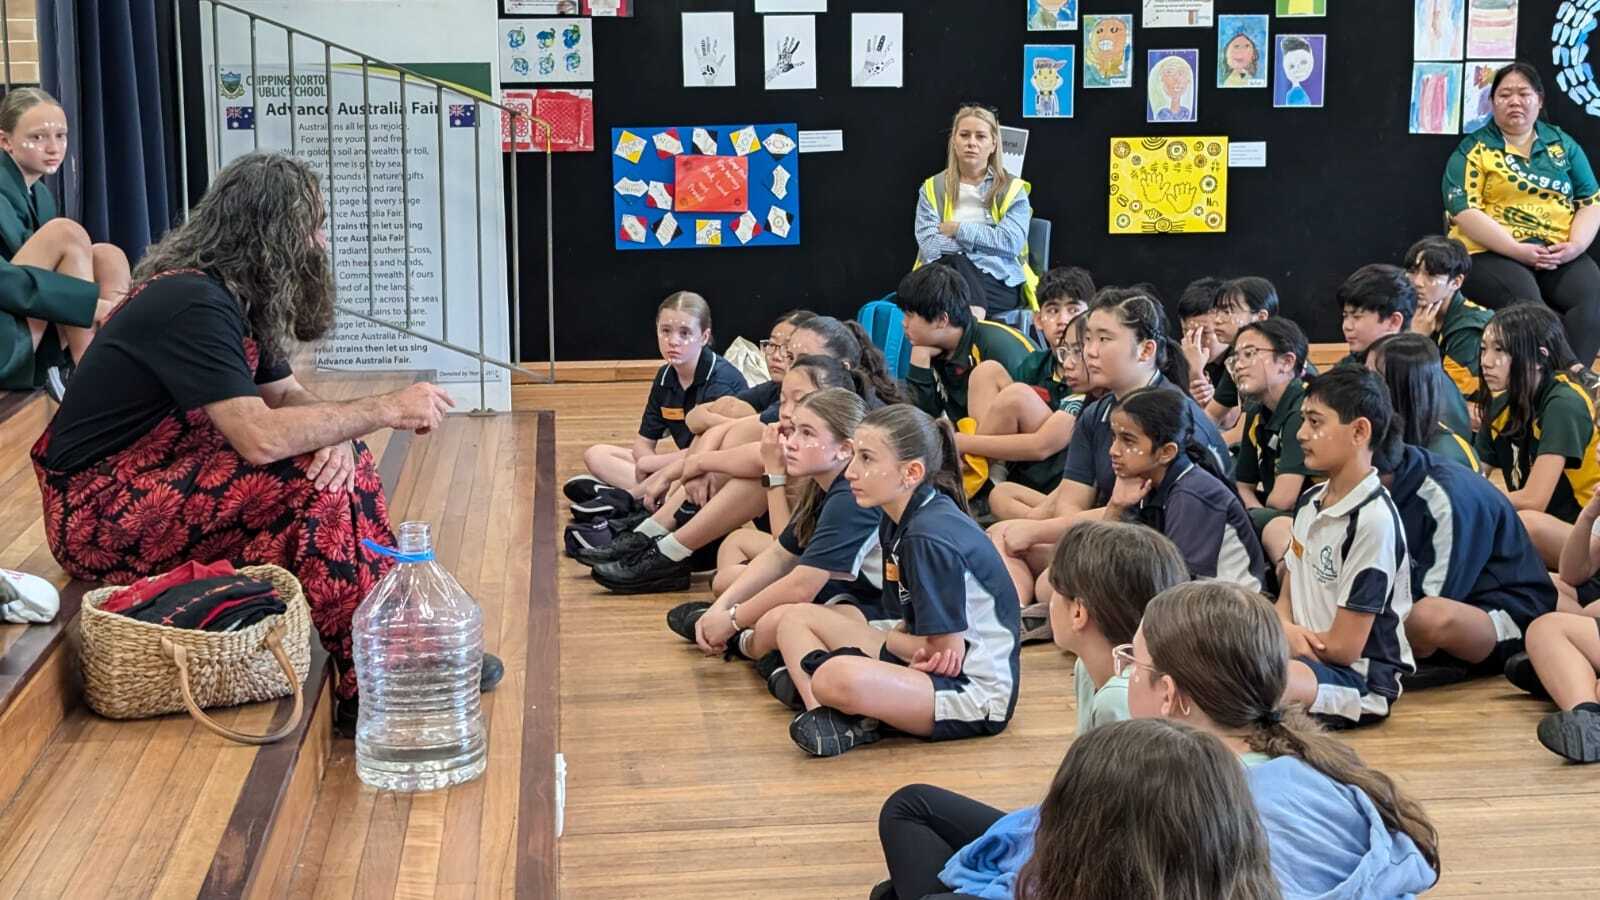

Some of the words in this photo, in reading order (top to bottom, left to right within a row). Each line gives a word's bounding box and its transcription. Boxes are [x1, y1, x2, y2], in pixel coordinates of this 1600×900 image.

[246, 75, 291, 86] CIPPING
[292, 75, 329, 86] NORTO
[255, 86, 286, 98] UBLIC
[288, 86, 327, 97] CHOOL
[299, 122, 344, 131] Australns
[345, 121, 355, 130] all
[357, 121, 368, 130] le
[301, 135, 315, 144] For
[344, 137, 368, 147] youn
[373, 134, 390, 142] and
[307, 147, 336, 157] gold
[371, 146, 400, 155] wealth
[325, 159, 350, 168] hme
[352, 160, 359, 168] is
[376, 159, 387, 170] by
[325, 172, 362, 181] aounds
[406, 170, 425, 182] gifts
[339, 198, 361, 208] page
[374, 197, 397, 208] every
[398, 198, 421, 207] sge
[350, 208, 386, 218] Austalia
[334, 221, 358, 230] rains
[359, 221, 379, 230] thn
[380, 220, 392, 230] let
[393, 222, 404, 230] us
[408, 221, 424, 231] ing
[350, 233, 387, 242] Austalia
[338, 247, 368, 255] radiant
[373, 245, 407, 254] outhern
[352, 259, 379, 267] heas
[380, 258, 396, 266] and
[397, 257, 425, 267] hads,
[339, 270, 405, 280] Commwealth
[416, 271, 435, 279] ours
[353, 283, 363, 291] of
[375, 283, 390, 291] the
[379, 296, 404, 304] across
[422, 296, 440, 304] seas
[367, 308, 391, 316] pains
[392, 307, 402, 315] to
[356, 319, 367, 329] let
[328, 332, 360, 342] dvance
[361, 331, 396, 341] Australia
[335, 343, 363, 353] strains
[364, 343, 385, 352] then
[386, 343, 398, 352] let
[410, 343, 428, 353] sing
[318, 357, 354, 366] Advance
[355, 356, 392, 365] Australia
[394, 355, 412, 364] Fair.
